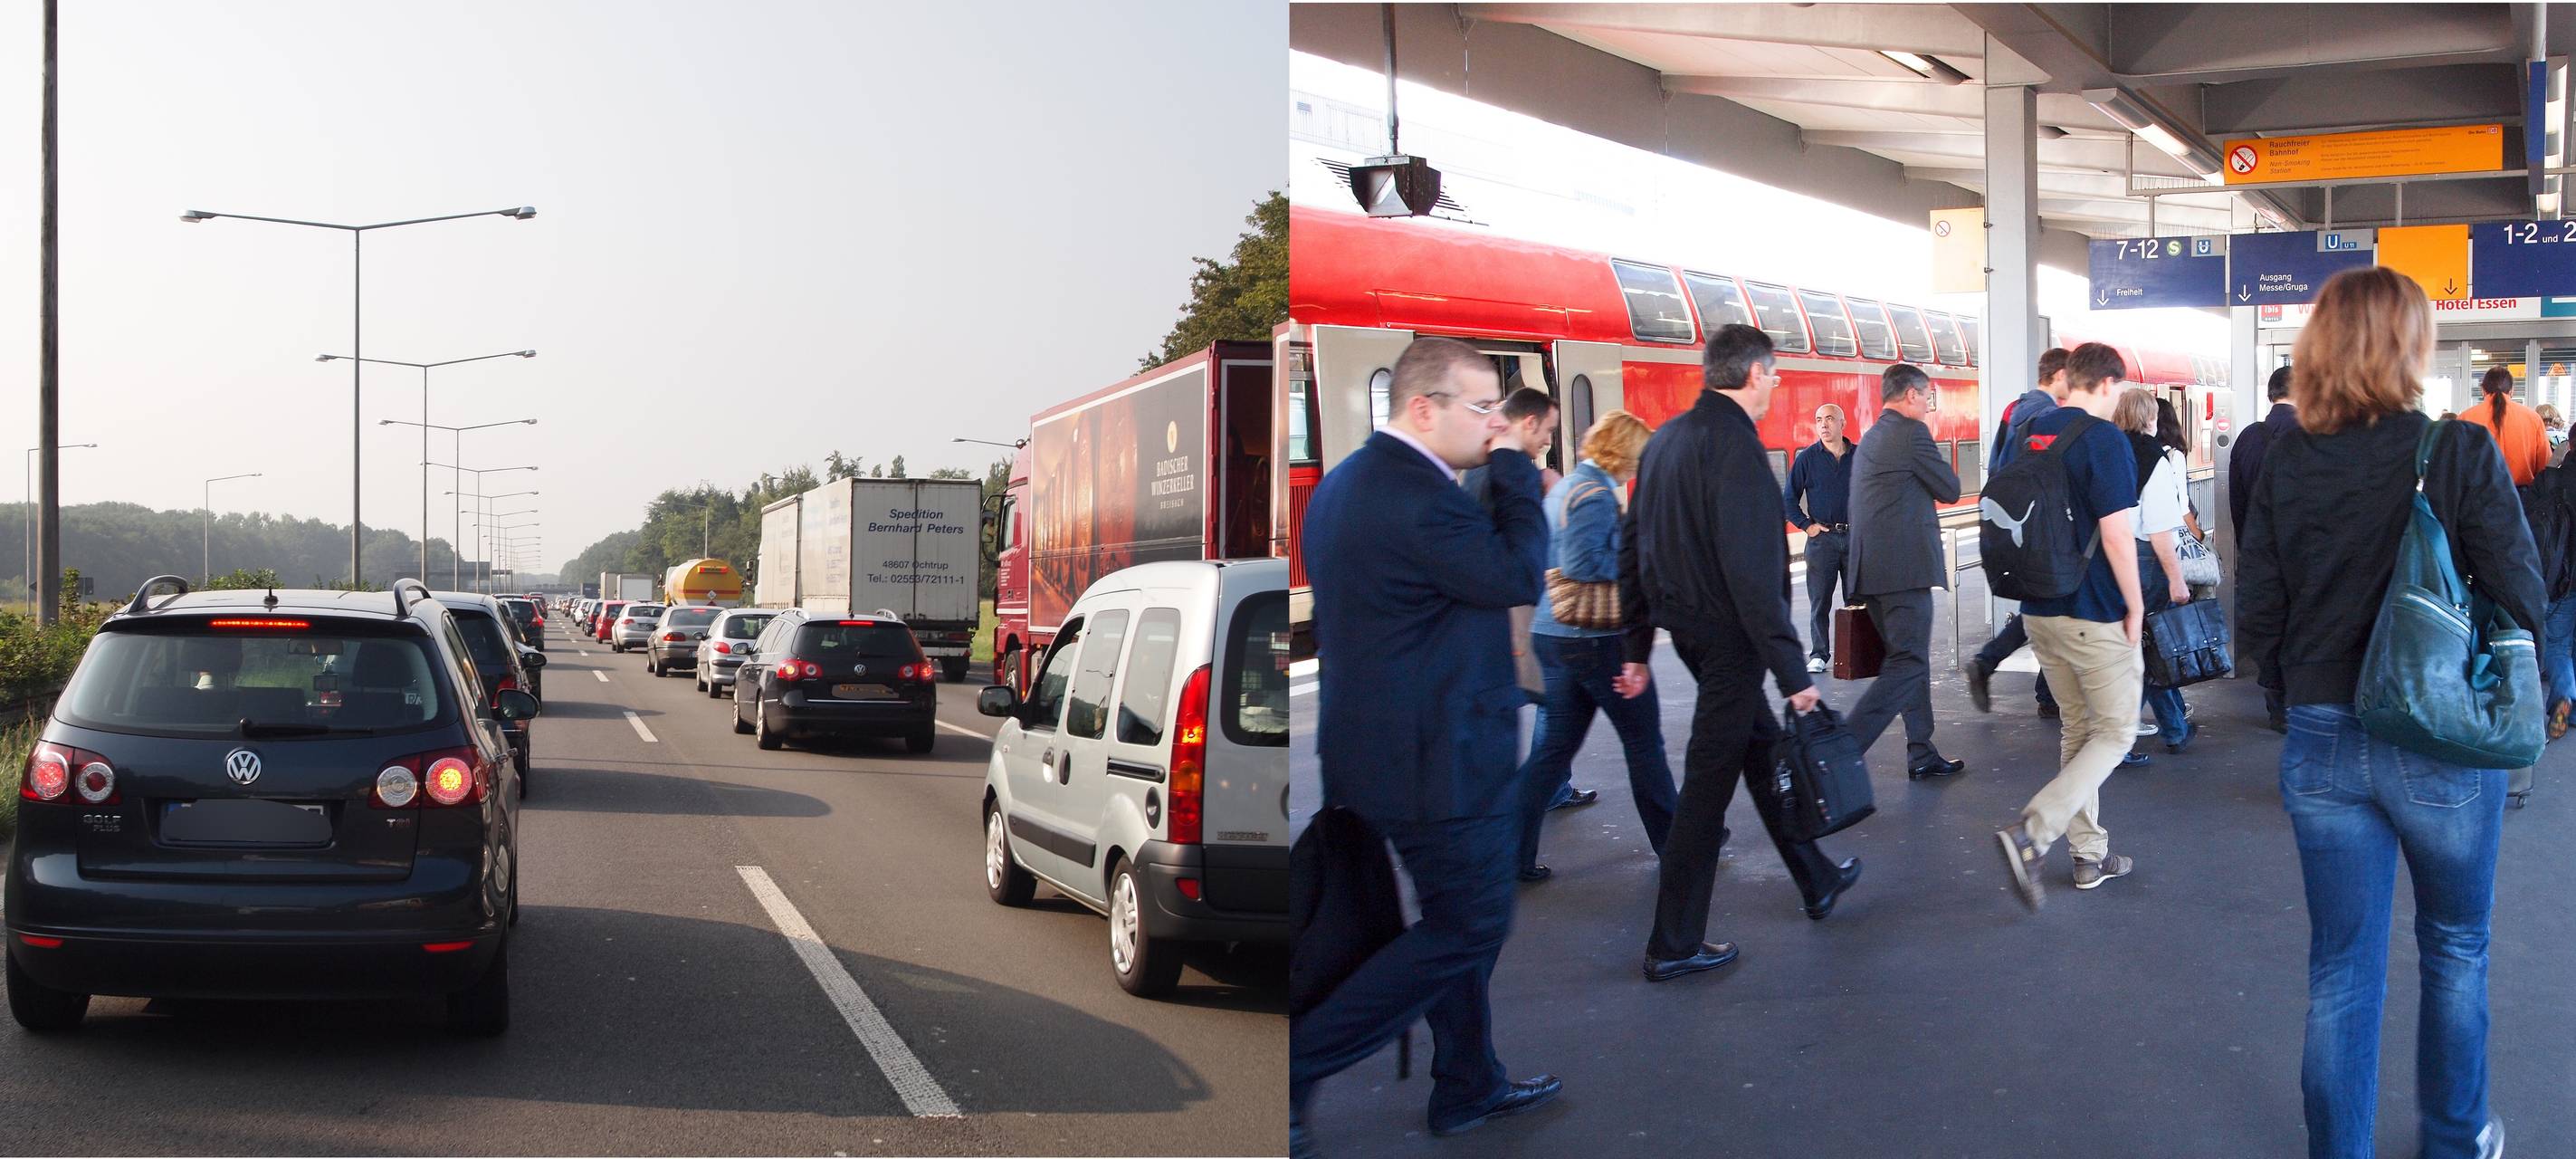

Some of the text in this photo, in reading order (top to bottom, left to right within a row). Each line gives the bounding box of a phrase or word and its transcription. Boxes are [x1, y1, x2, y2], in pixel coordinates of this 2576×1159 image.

[2269, 139, 2310, 148] Rauchfreier
[2269, 148, 2299, 157] Bahnhof
[2269, 159, 2311, 168] Non-Smoking
[2504, 223, 2538, 244] 1-2
[2542, 235, 2559, 243] und
[2327, 235, 2338, 249] U
[2116, 239, 2159, 260] 7-12
[2259, 273, 2292, 283] Ausgang
[2116, 288, 2143, 296] Freiheit
[2259, 283, 2308, 292] Messe/Gruga
[2436, 297, 2517, 311] Hotel Essen
[1157, 455, 1188, 477] BADISCHER
[1150, 474, 1195, 496] WINZERKELLER
[889, 509, 943, 521] Spedition
[868, 522, 964, 534] Bernhard Peters
[883, 560, 949, 570] 48607 Ochtrup
[867, 573, 964, 584] Tel.: 02553/72111-1
[82, 814, 122, 824] GOLF
